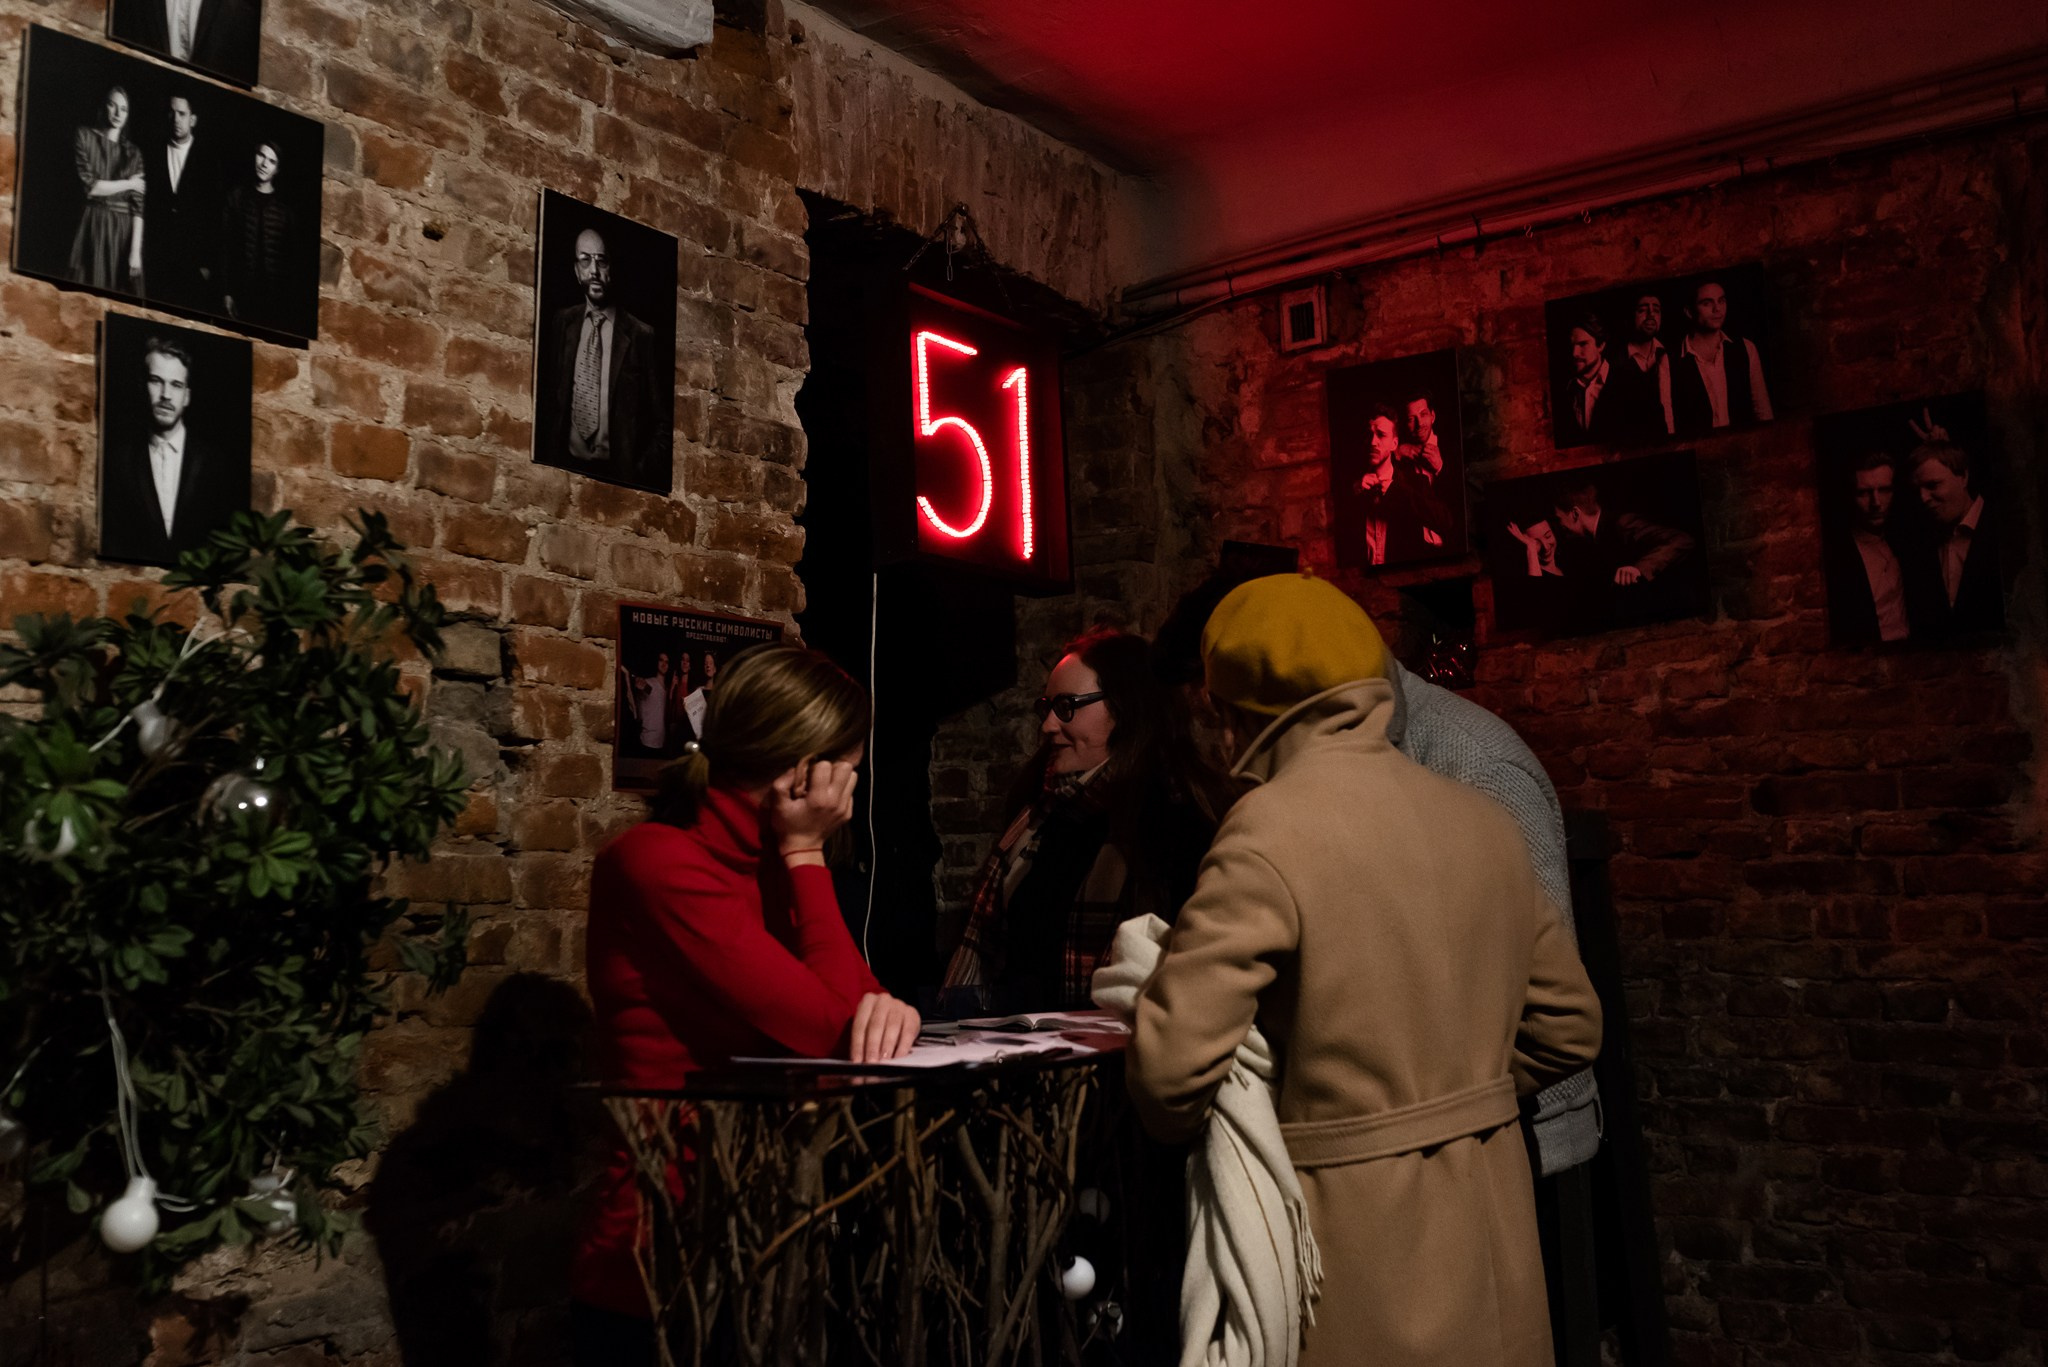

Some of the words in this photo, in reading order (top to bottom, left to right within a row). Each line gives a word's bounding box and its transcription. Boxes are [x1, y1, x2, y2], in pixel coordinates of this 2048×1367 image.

[916, 330, 1034, 560] 51
[632, 611, 669, 626] НОВЫЕ
[672, 616, 713, 632] РУССКИЕ
[715, 622, 773, 640] СИМВОЛИСТЫ
